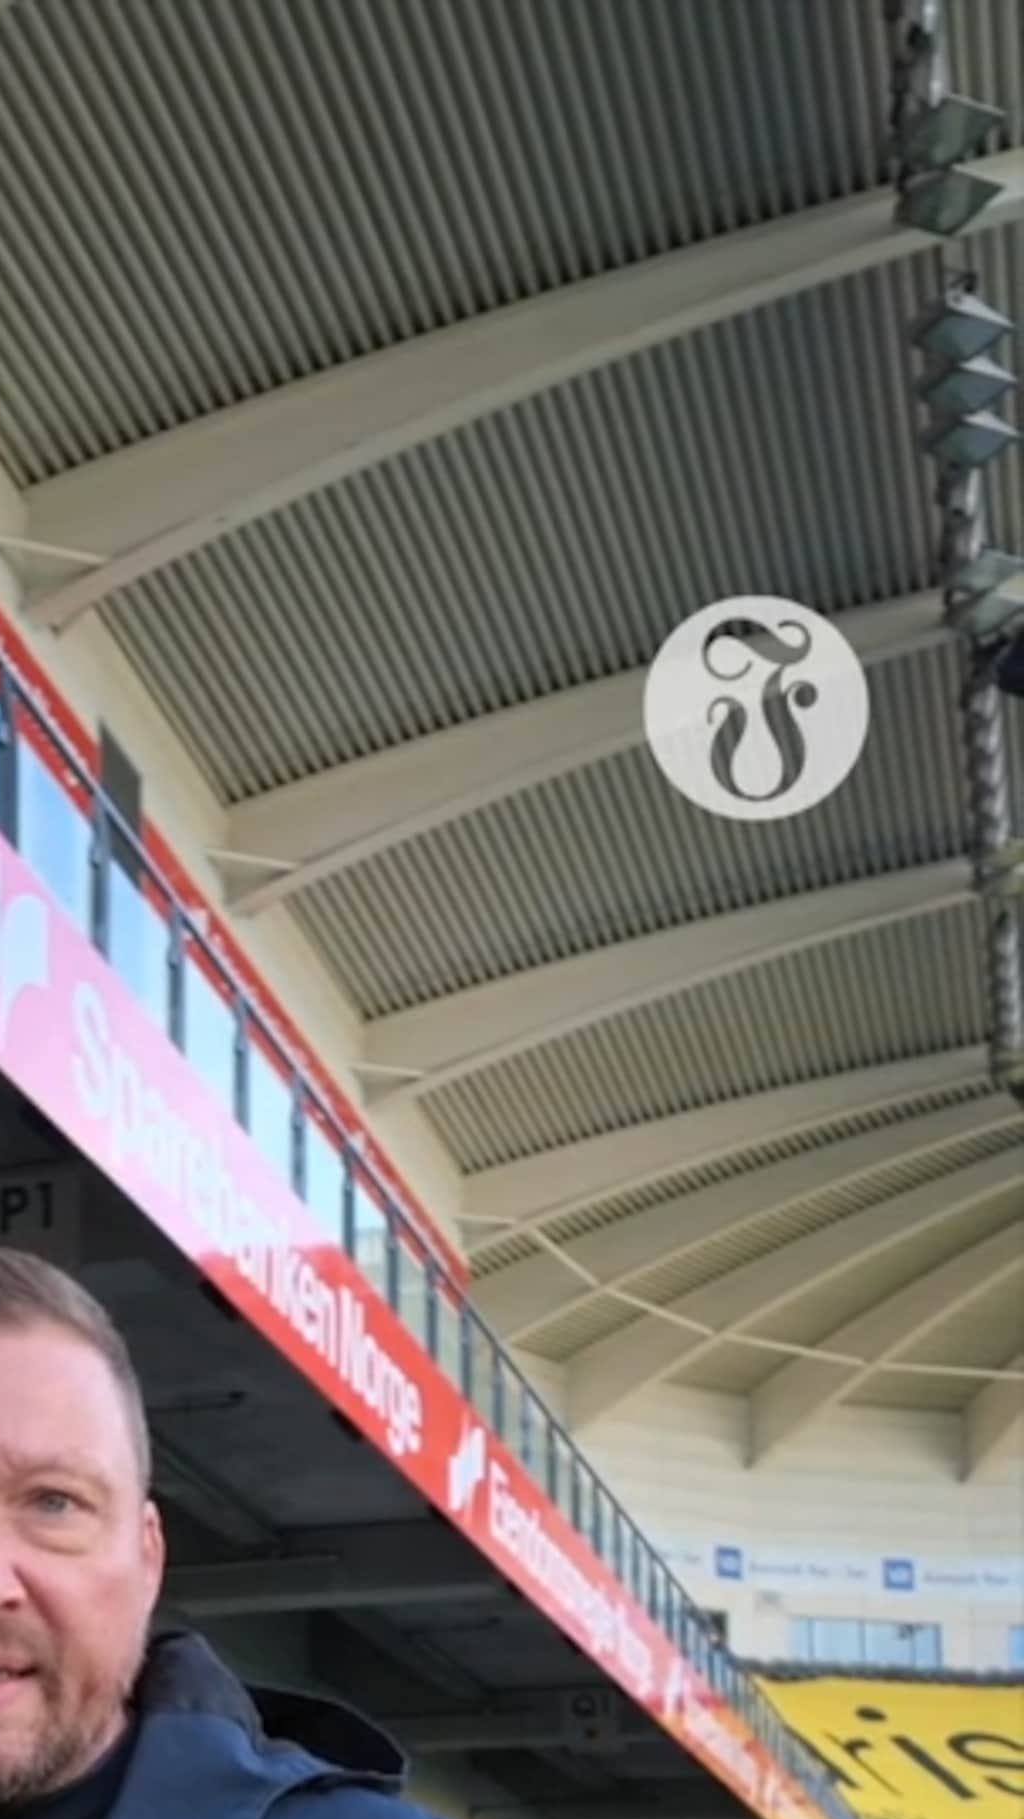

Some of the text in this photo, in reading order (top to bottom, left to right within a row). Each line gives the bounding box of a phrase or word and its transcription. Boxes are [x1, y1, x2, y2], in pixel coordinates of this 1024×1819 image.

[0, 1182, 53, 1234] P1
[73, 980, 339, 1369] Sparebanken
[338, 1286, 423, 1457] Norge
